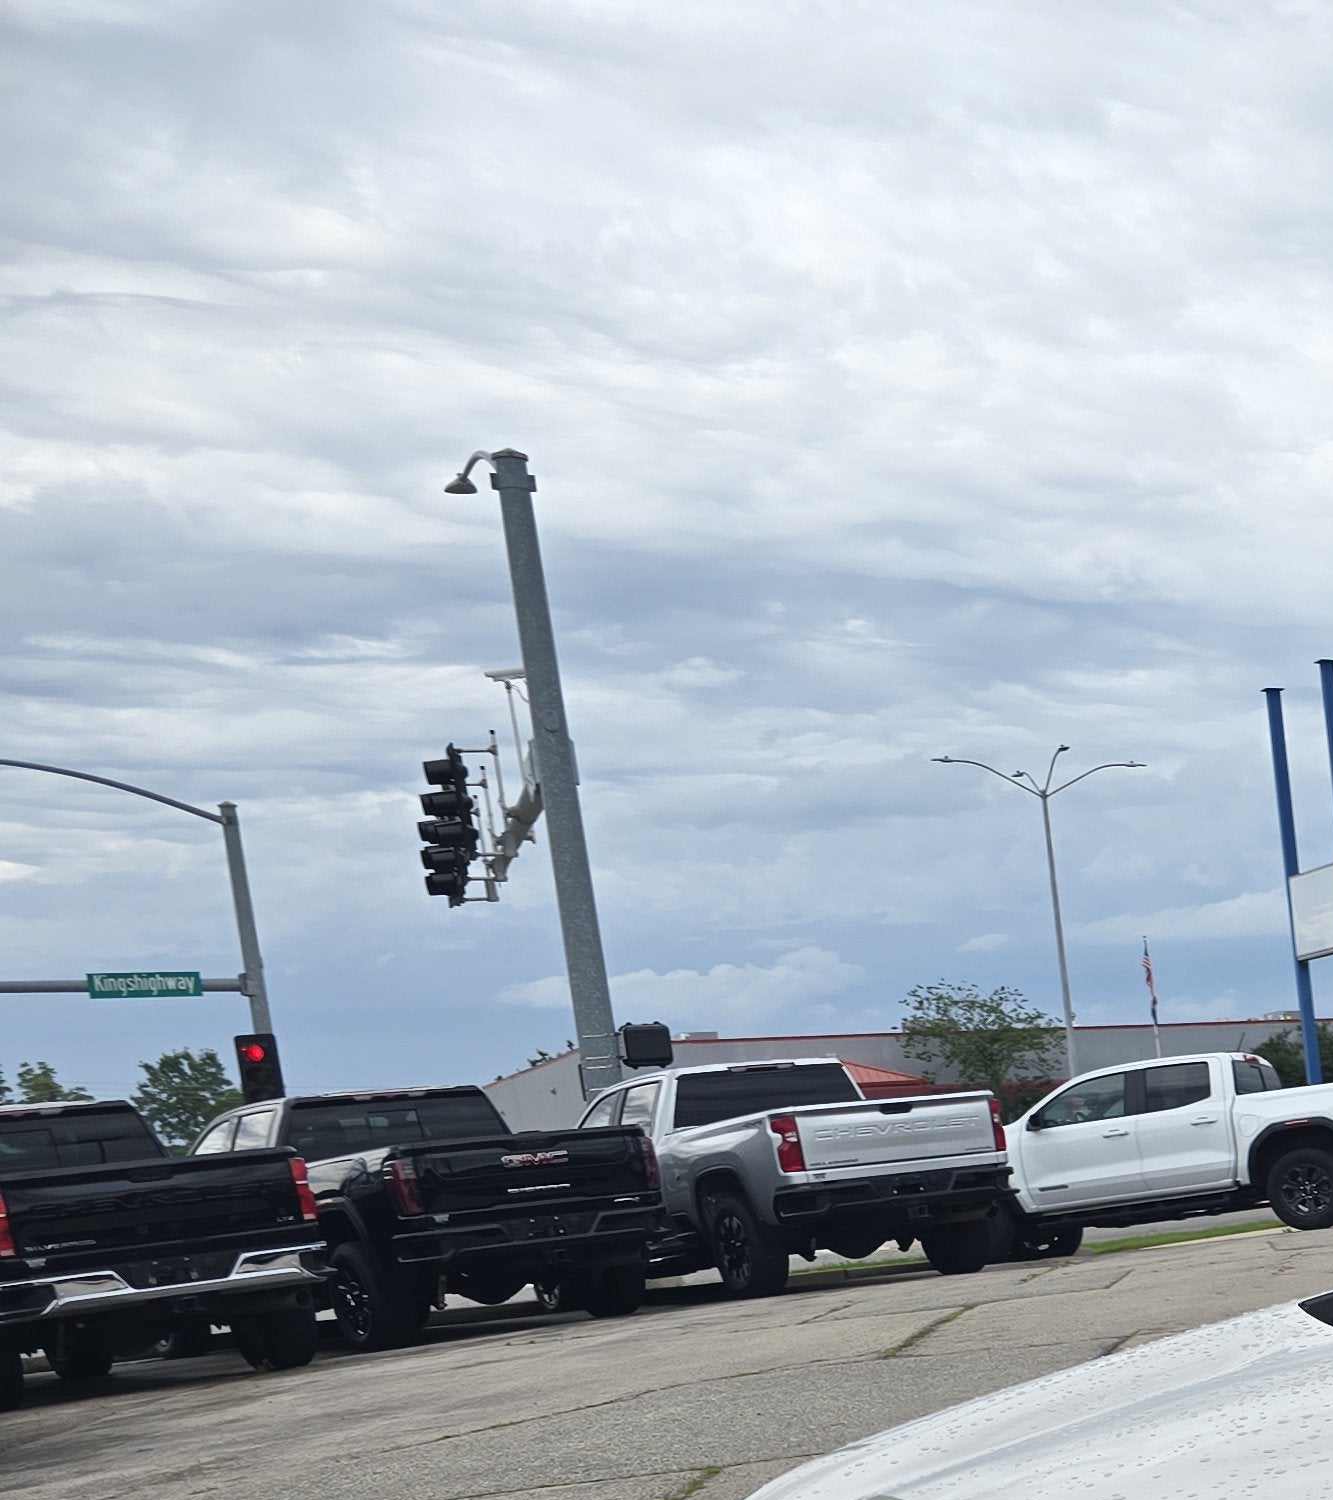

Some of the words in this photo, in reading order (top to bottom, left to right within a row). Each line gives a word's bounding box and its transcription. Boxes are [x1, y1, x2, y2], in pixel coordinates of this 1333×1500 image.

[93, 974, 196, 997] Kingshighway
[815, 1114, 980, 1142] CHEVROLET
[501, 1150, 569, 1168] GMC
